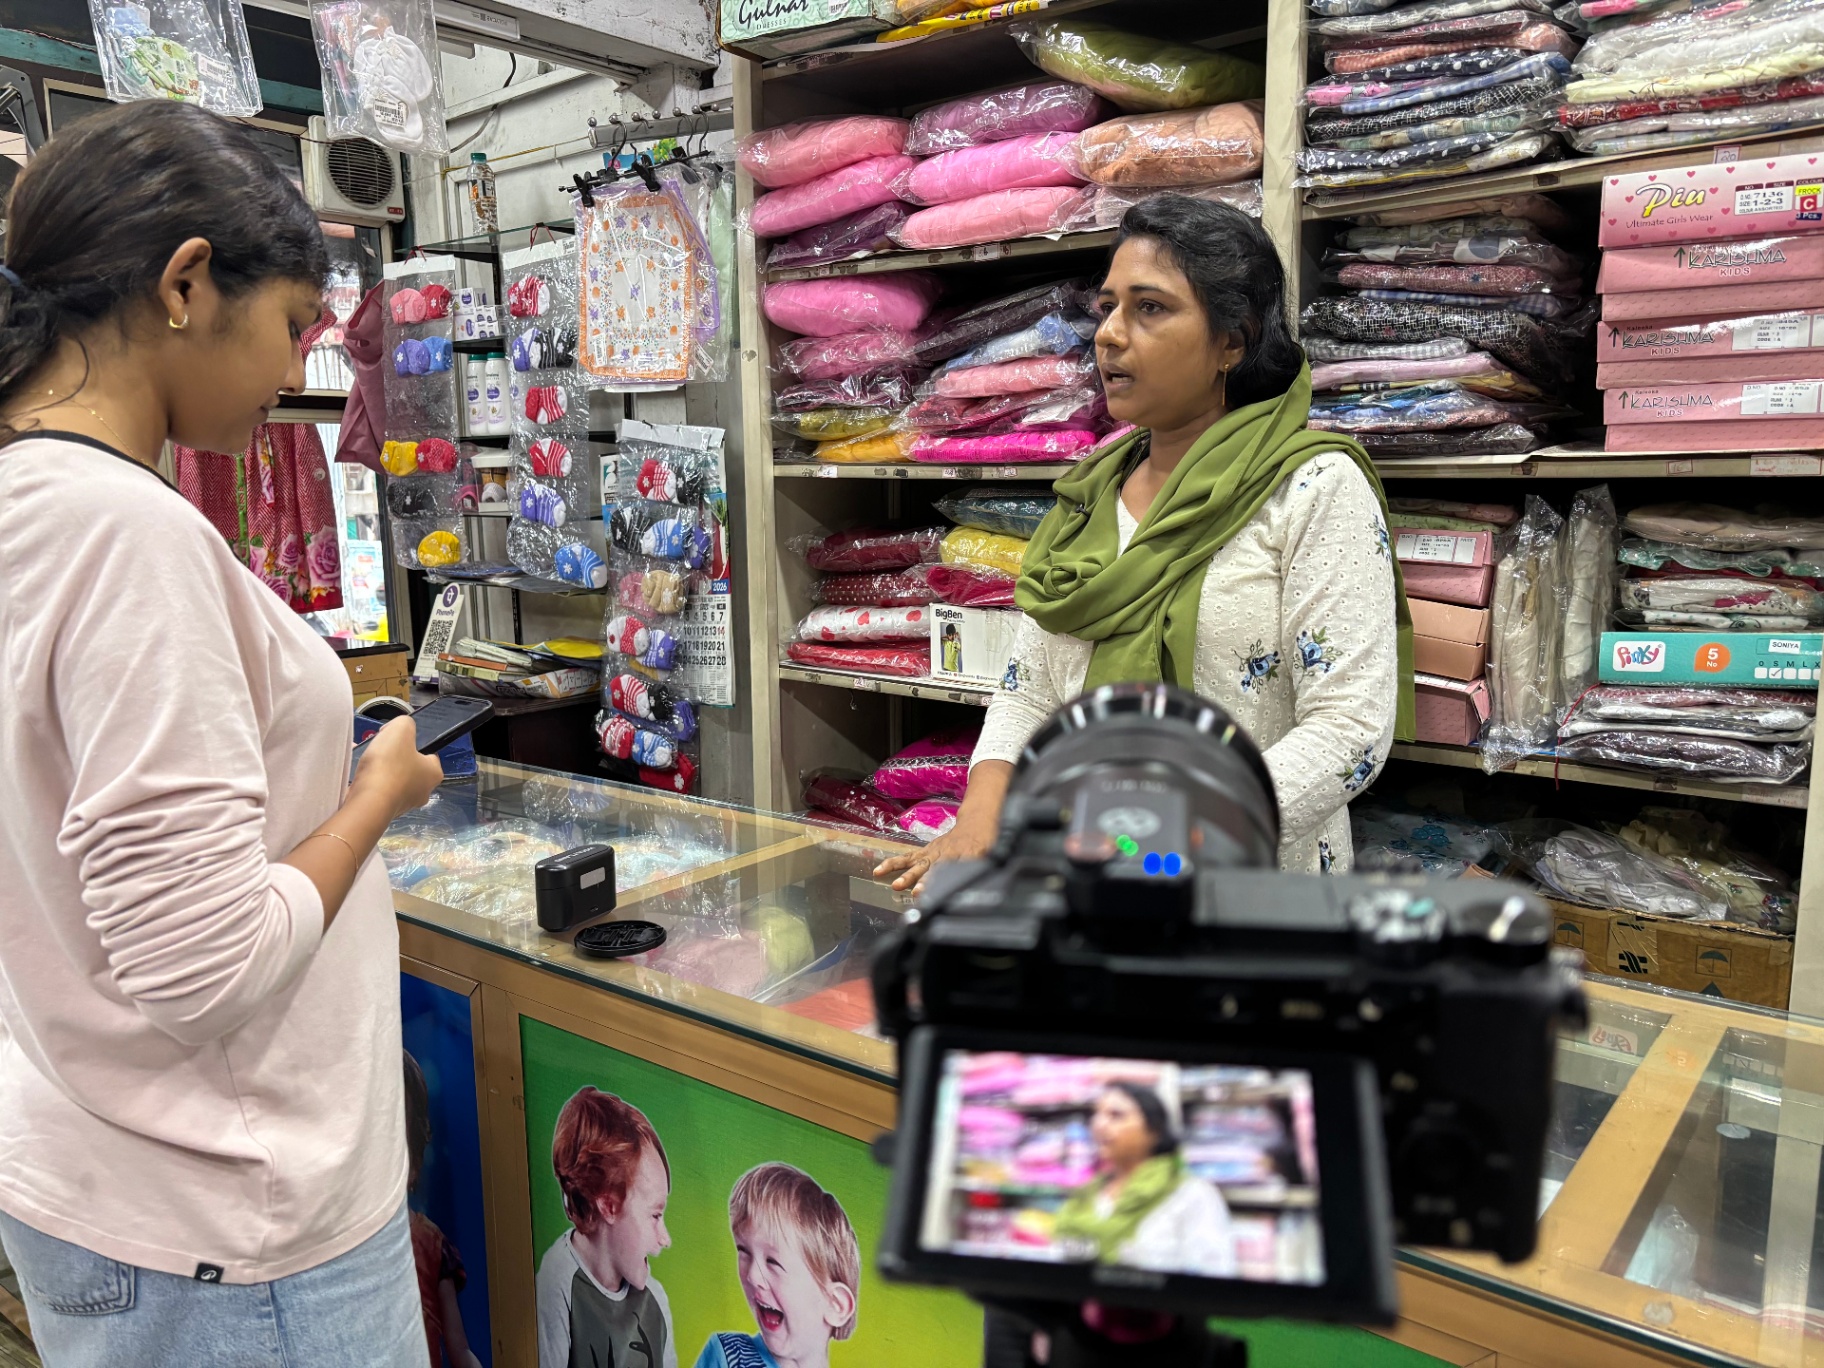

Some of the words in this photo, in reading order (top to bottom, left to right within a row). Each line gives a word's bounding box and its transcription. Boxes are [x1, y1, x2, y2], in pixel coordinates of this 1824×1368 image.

[1753, 191, 1783, 199] 7136
[1798, 187, 1821, 195] FROCK
[1753, 198, 1783, 206] 1-2-3
[1803, 198, 1815, 210] C
[1626, 219, 1664, 228] Ultimate
[1689, 214, 1713, 223] Wear
[1719, 267, 1750, 277] KIDS
[1650, 346, 1680, 356] KIDS
[1630, 392, 1713, 410] KARISHMA
[1656, 409, 1684, 418] KIDS
[712, 583, 728, 592] 2026
[935, 608, 963, 620] BigBen
[1772, 641, 1799, 649] SONIYA
[1707, 648, 1718, 659] 5
